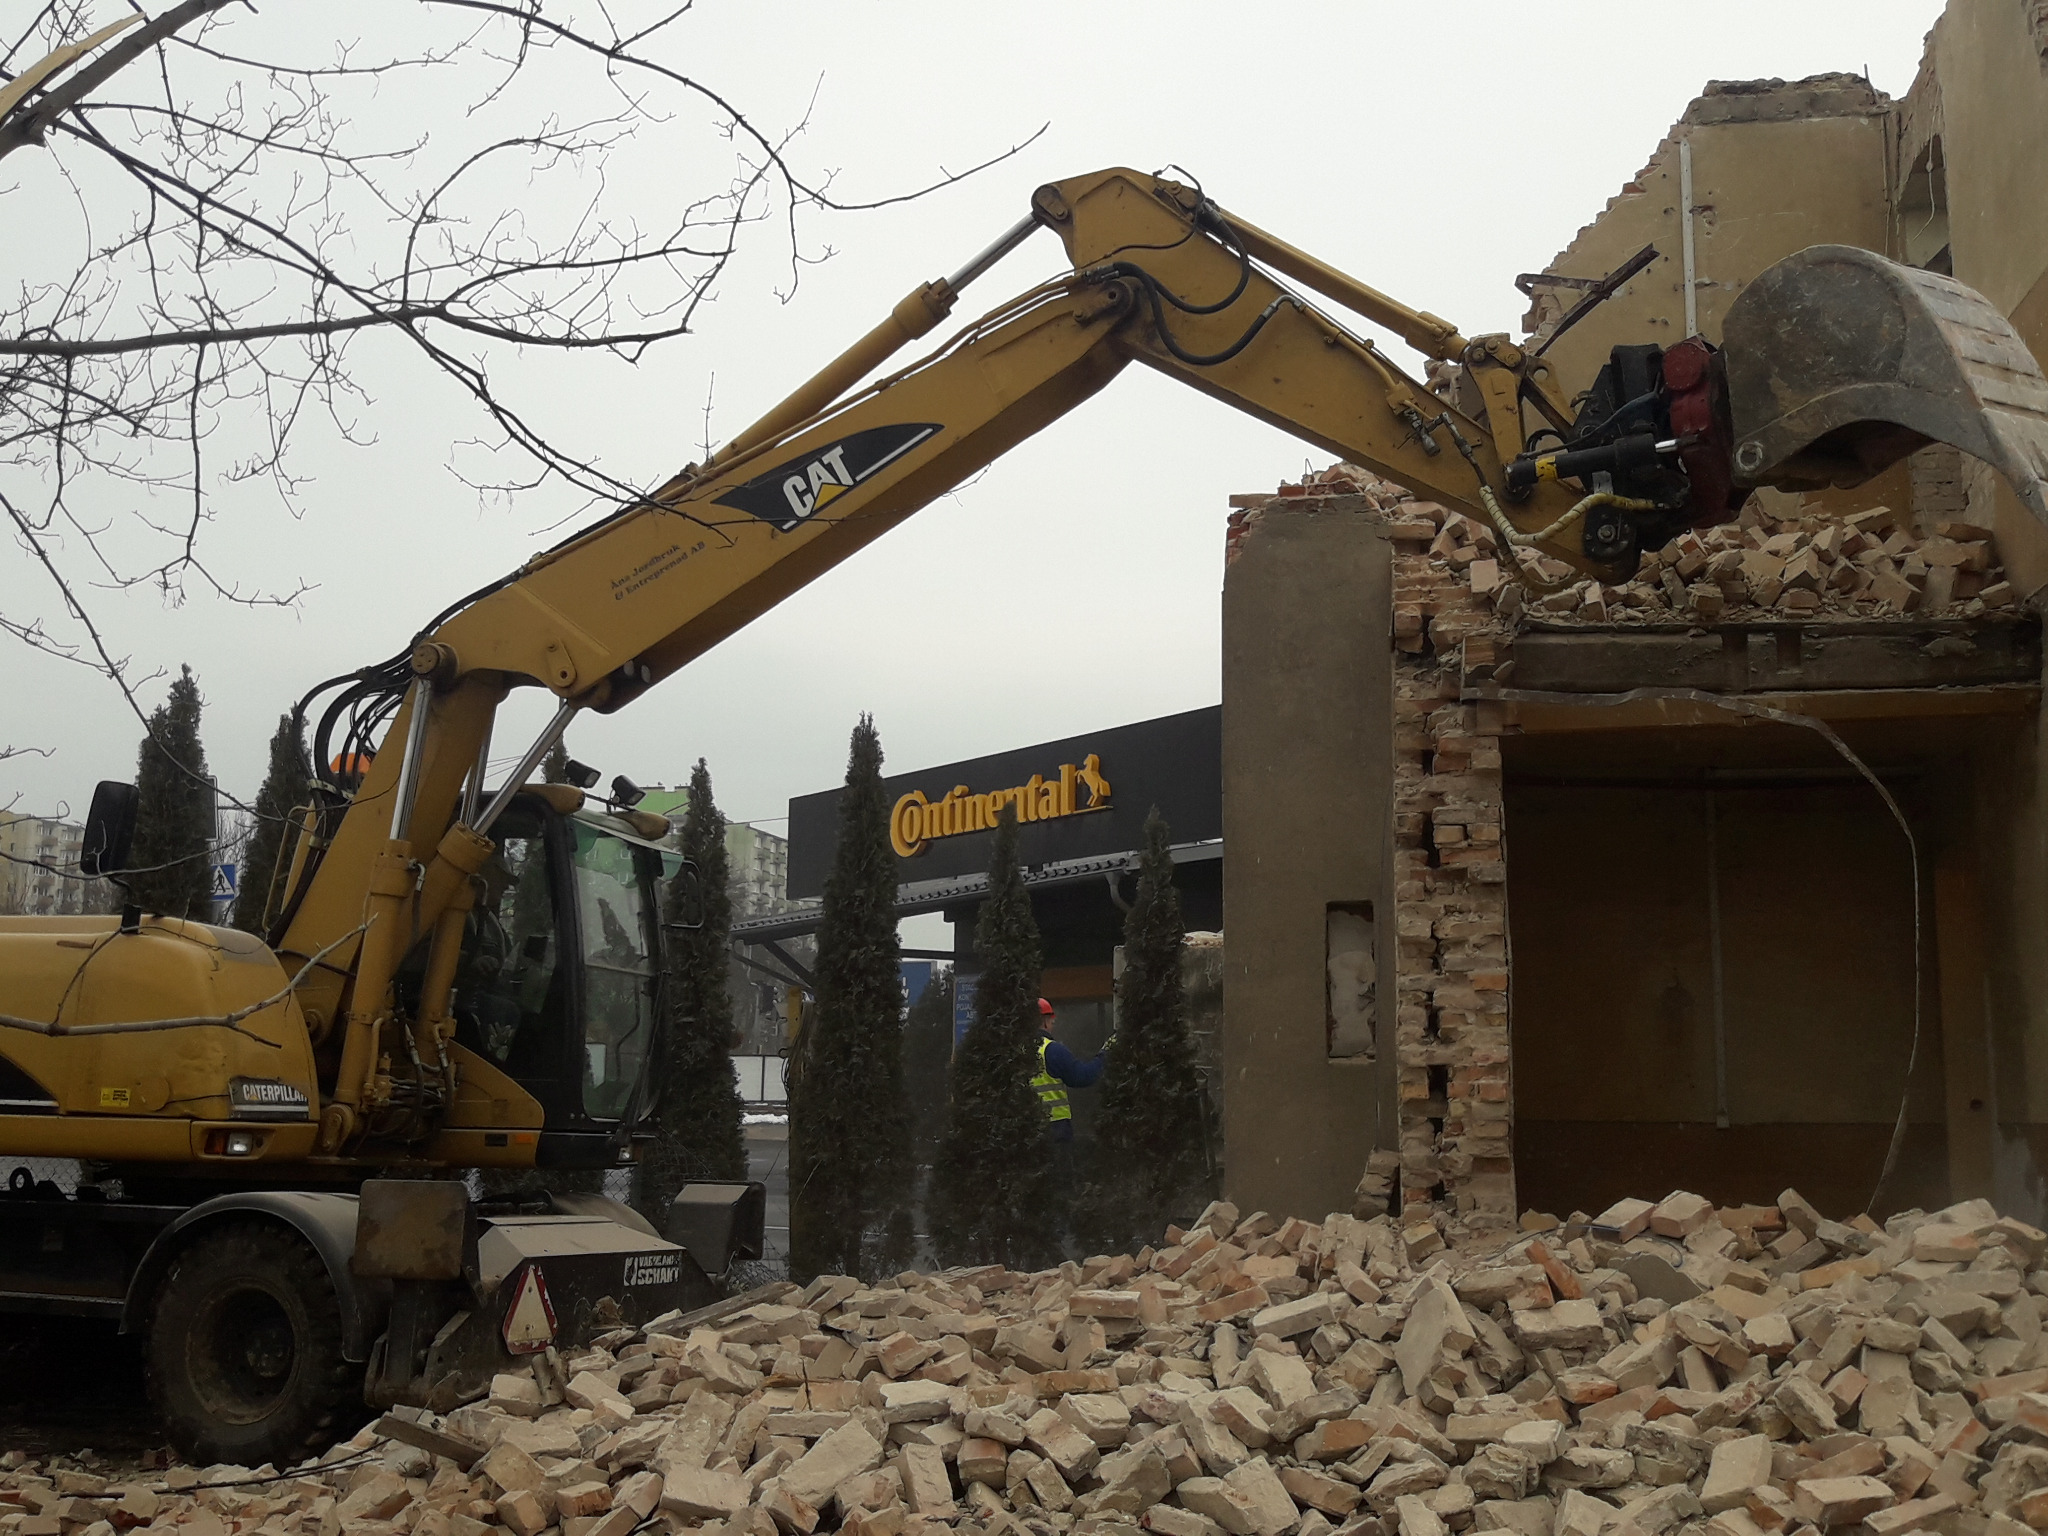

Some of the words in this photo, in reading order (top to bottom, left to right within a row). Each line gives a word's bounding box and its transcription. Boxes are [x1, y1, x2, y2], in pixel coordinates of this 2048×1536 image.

[783, 445, 854, 518] CAT
[625, 552, 689, 595] Entreprenad
[691, 541, 706, 555] AB
[632, 544, 681, 577] Jordbruk
[890, 764, 1076, 857] Continental
